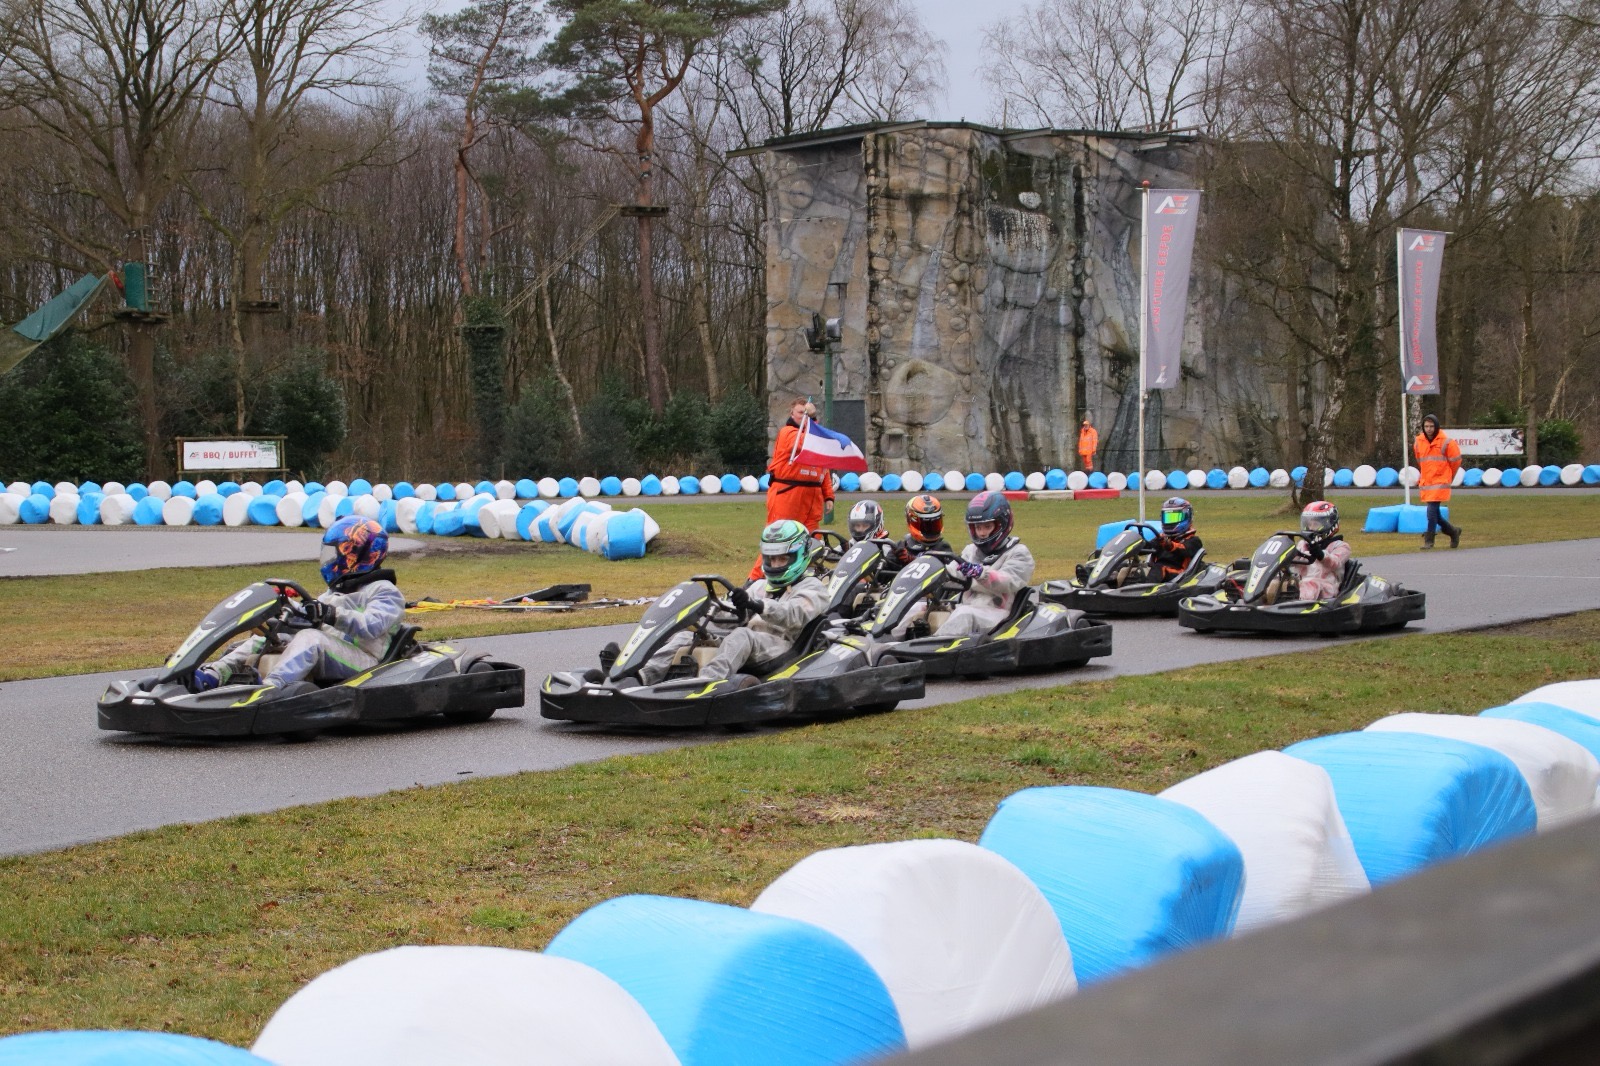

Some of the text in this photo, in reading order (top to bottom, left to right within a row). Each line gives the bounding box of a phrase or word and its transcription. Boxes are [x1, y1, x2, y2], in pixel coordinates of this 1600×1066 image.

[1157, 224, 1174, 267] EEFDE
[203, 451, 220, 459] BBQ
[228, 451, 257, 459] BUFFET
[1114, 533, 1127, 546] 1
[1261, 540, 1283, 555] 10
[845, 547, 863, 563] 3
[900, 562, 931, 579] 29
[224, 589, 253, 609] 9
[658, 588, 684, 608] 6
